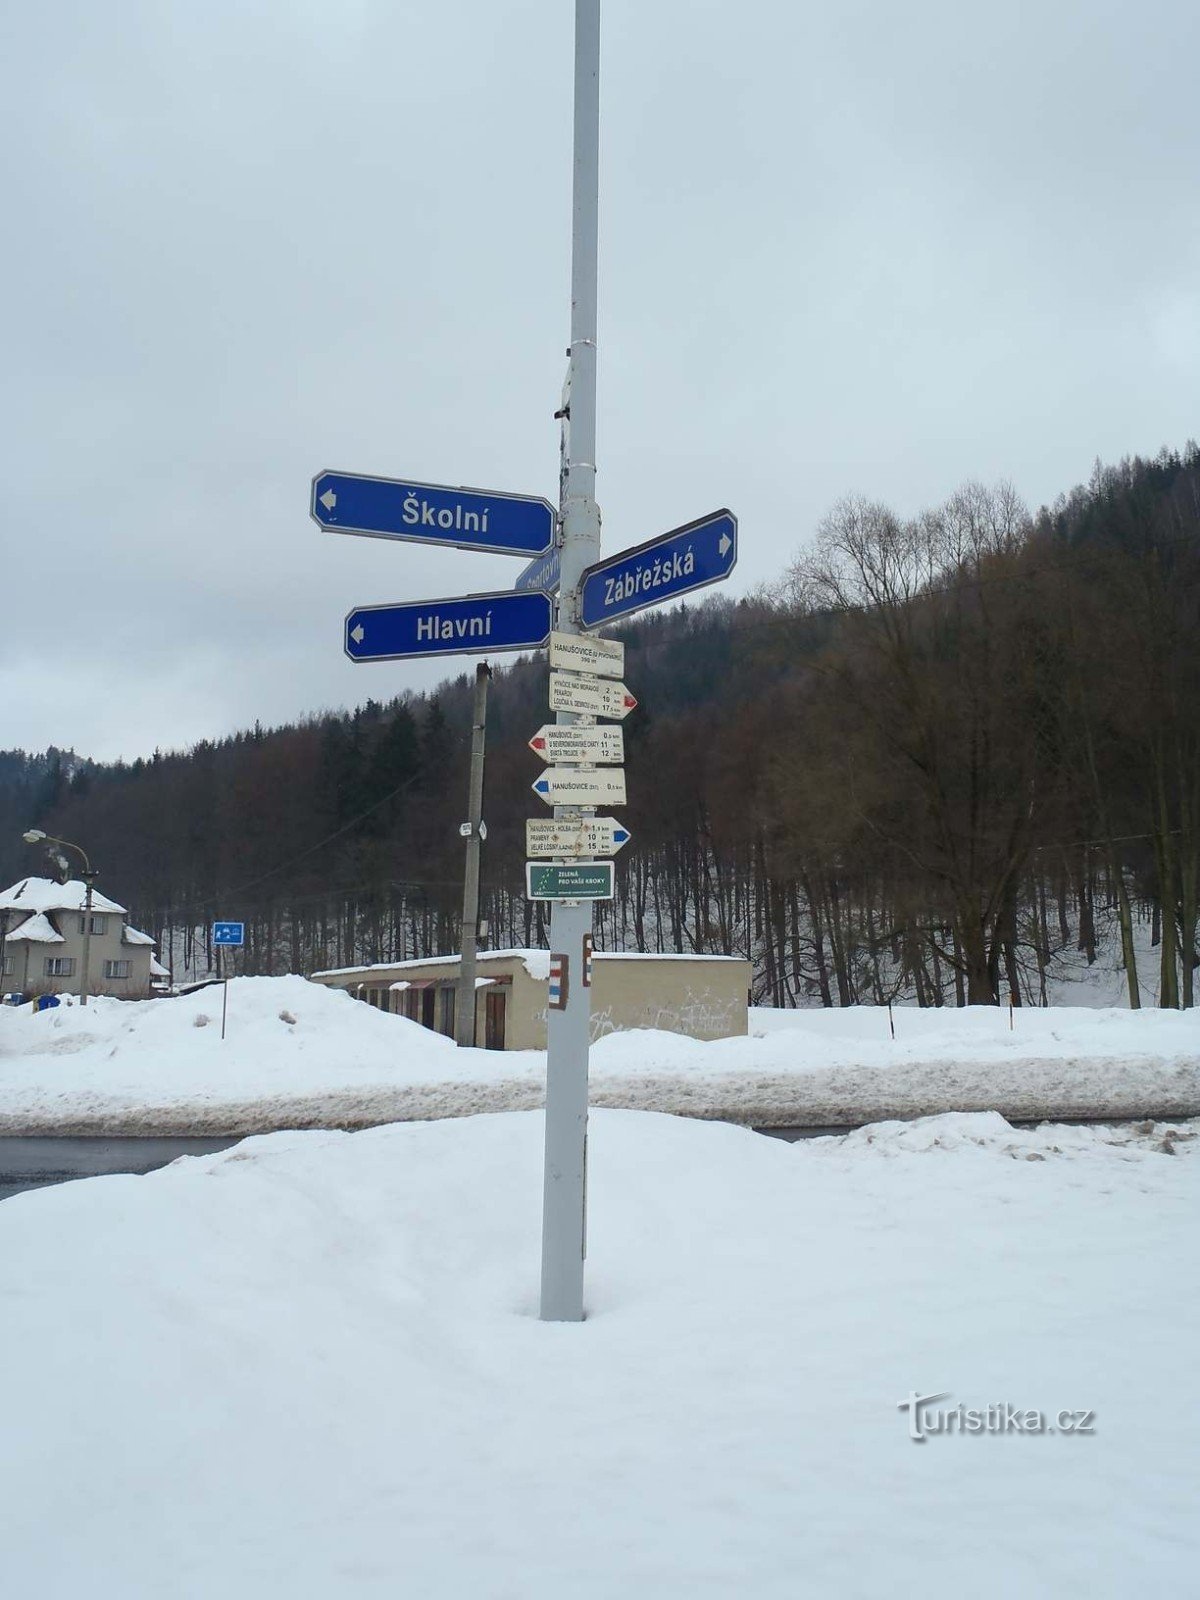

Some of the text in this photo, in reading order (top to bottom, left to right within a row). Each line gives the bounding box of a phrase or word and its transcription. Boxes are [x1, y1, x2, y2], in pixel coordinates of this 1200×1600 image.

[402, 491, 490, 533] Školní
[604, 545, 695, 606] Zábřežská
[416, 611, 493, 641] Hlavní
[554, 644, 593, 656] HANUŠOVICE
[602, 695, 610, 703] 10
[548, 731, 572, 739] HANUŠOVICE
[552, 782, 589, 790] HANUŠOVICE
[587, 842, 597, 850] 15
